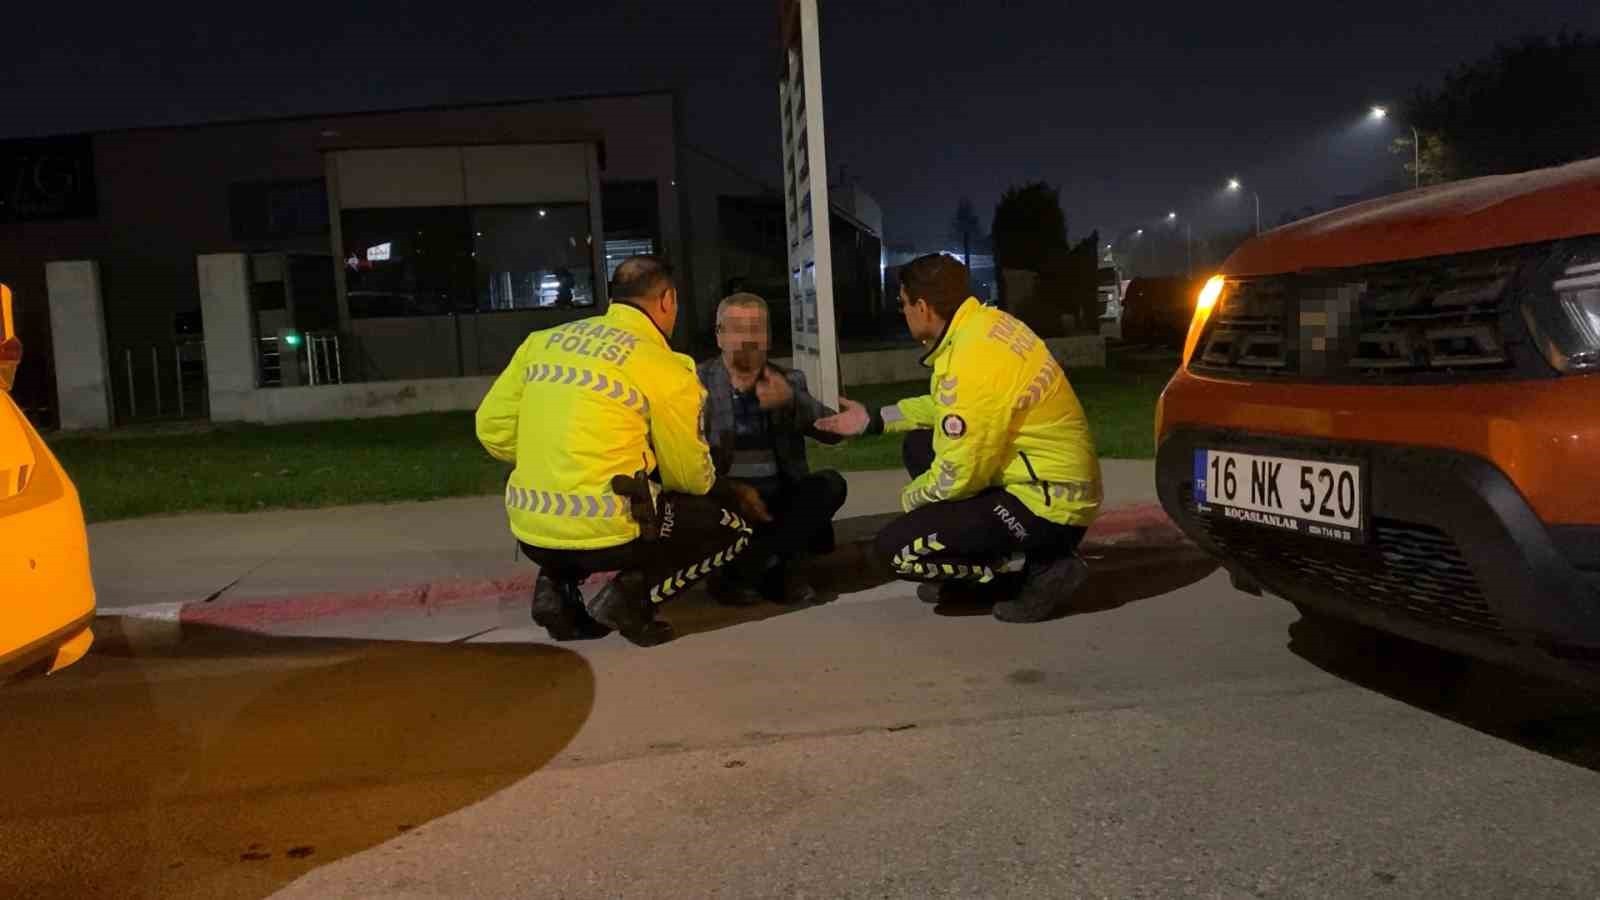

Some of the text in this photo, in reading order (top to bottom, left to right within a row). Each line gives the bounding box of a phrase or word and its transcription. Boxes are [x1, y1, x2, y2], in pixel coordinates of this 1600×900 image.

[1211, 455, 1355, 519] 16 NK 520
